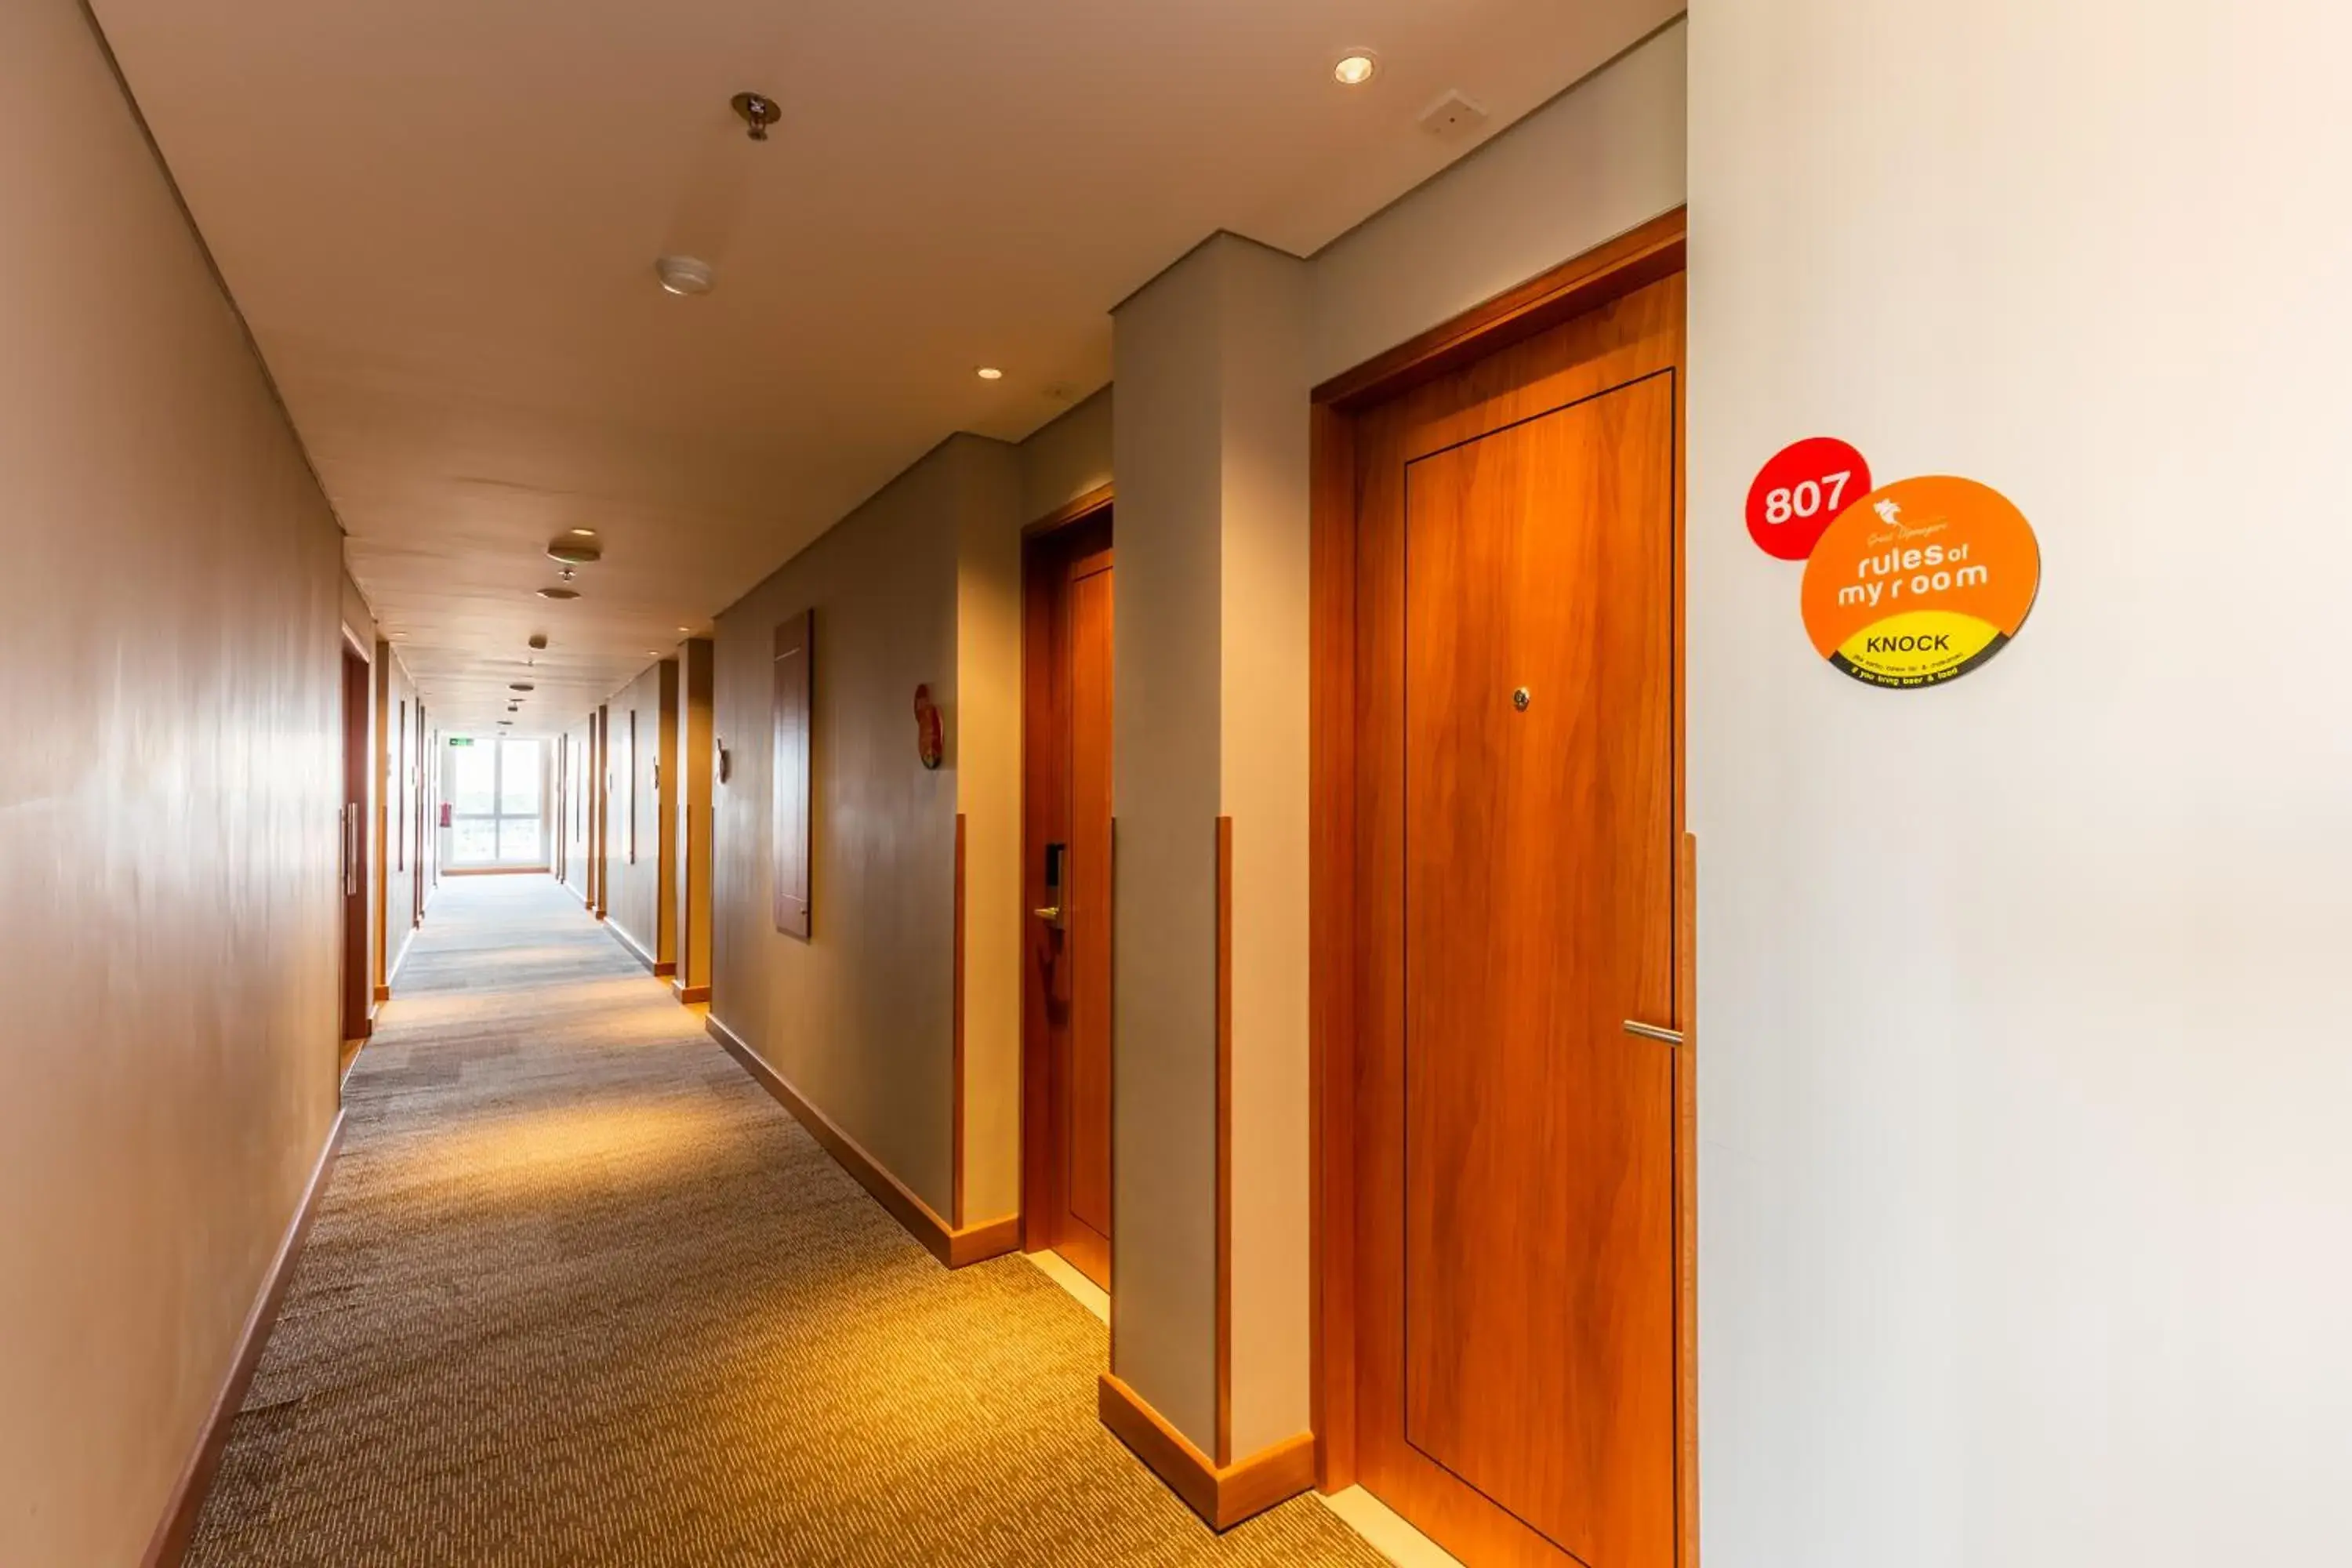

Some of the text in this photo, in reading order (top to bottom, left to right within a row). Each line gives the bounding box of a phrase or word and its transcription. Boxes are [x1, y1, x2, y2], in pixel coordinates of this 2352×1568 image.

[1766, 470, 1851, 524] 807
[1858, 545, 1944, 578] rules
[1838, 582, 1883, 607] my
[1867, 634, 1950, 652] KNOCK
